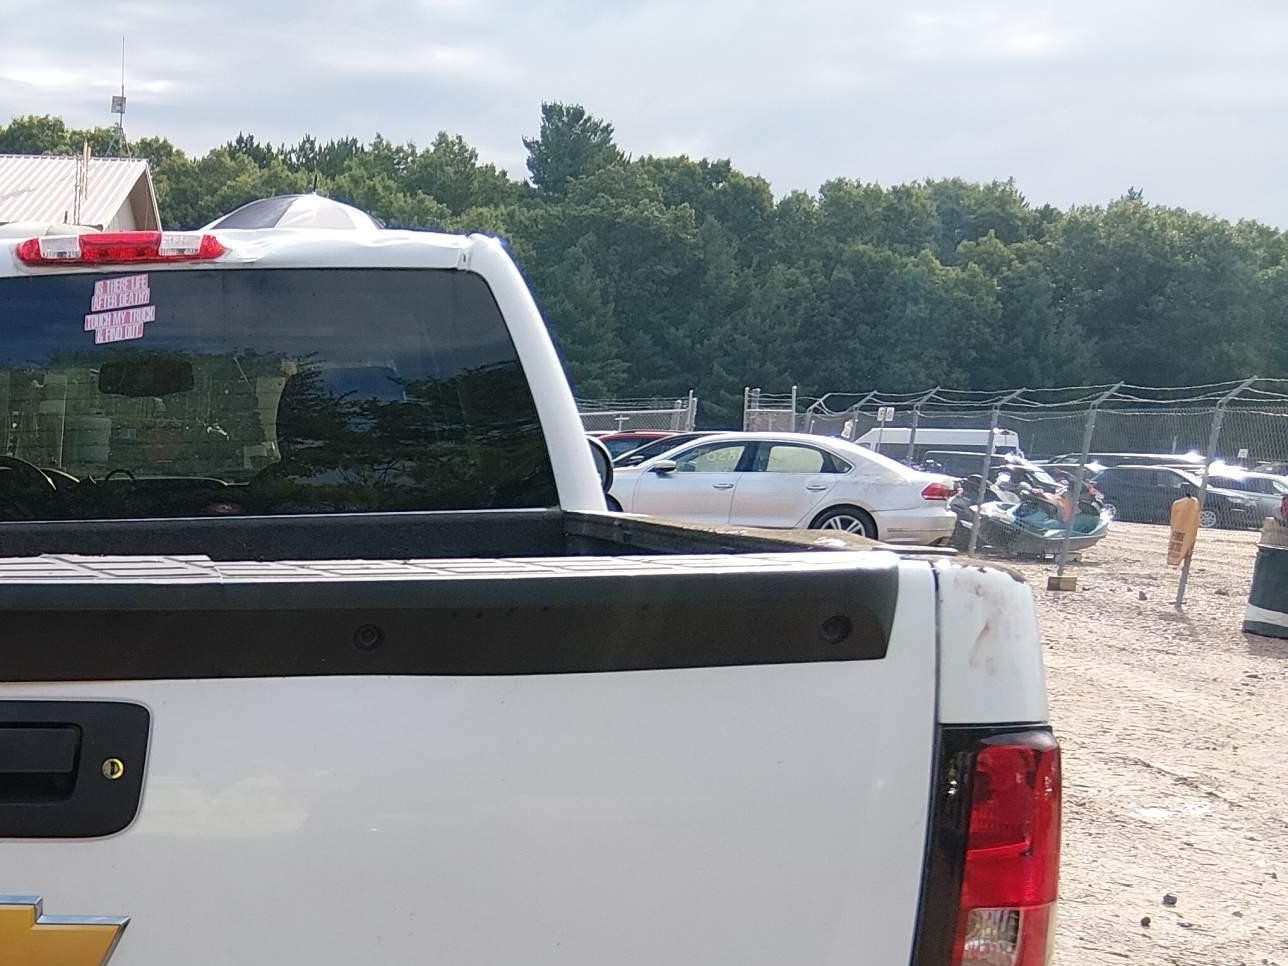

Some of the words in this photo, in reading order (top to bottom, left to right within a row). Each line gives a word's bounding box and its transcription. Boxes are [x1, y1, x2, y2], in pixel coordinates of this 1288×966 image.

[107, 277, 130, 292] THERE
[132, 274, 148, 290] LIFE
[93, 293, 118, 310] AFTER
[119, 289, 150, 307] DEATH?
[85, 313, 112, 330] TOUCH
[112, 311, 127, 327] MY
[129, 306, 155, 323] TRUCK
[105, 327, 123, 342] FIND
